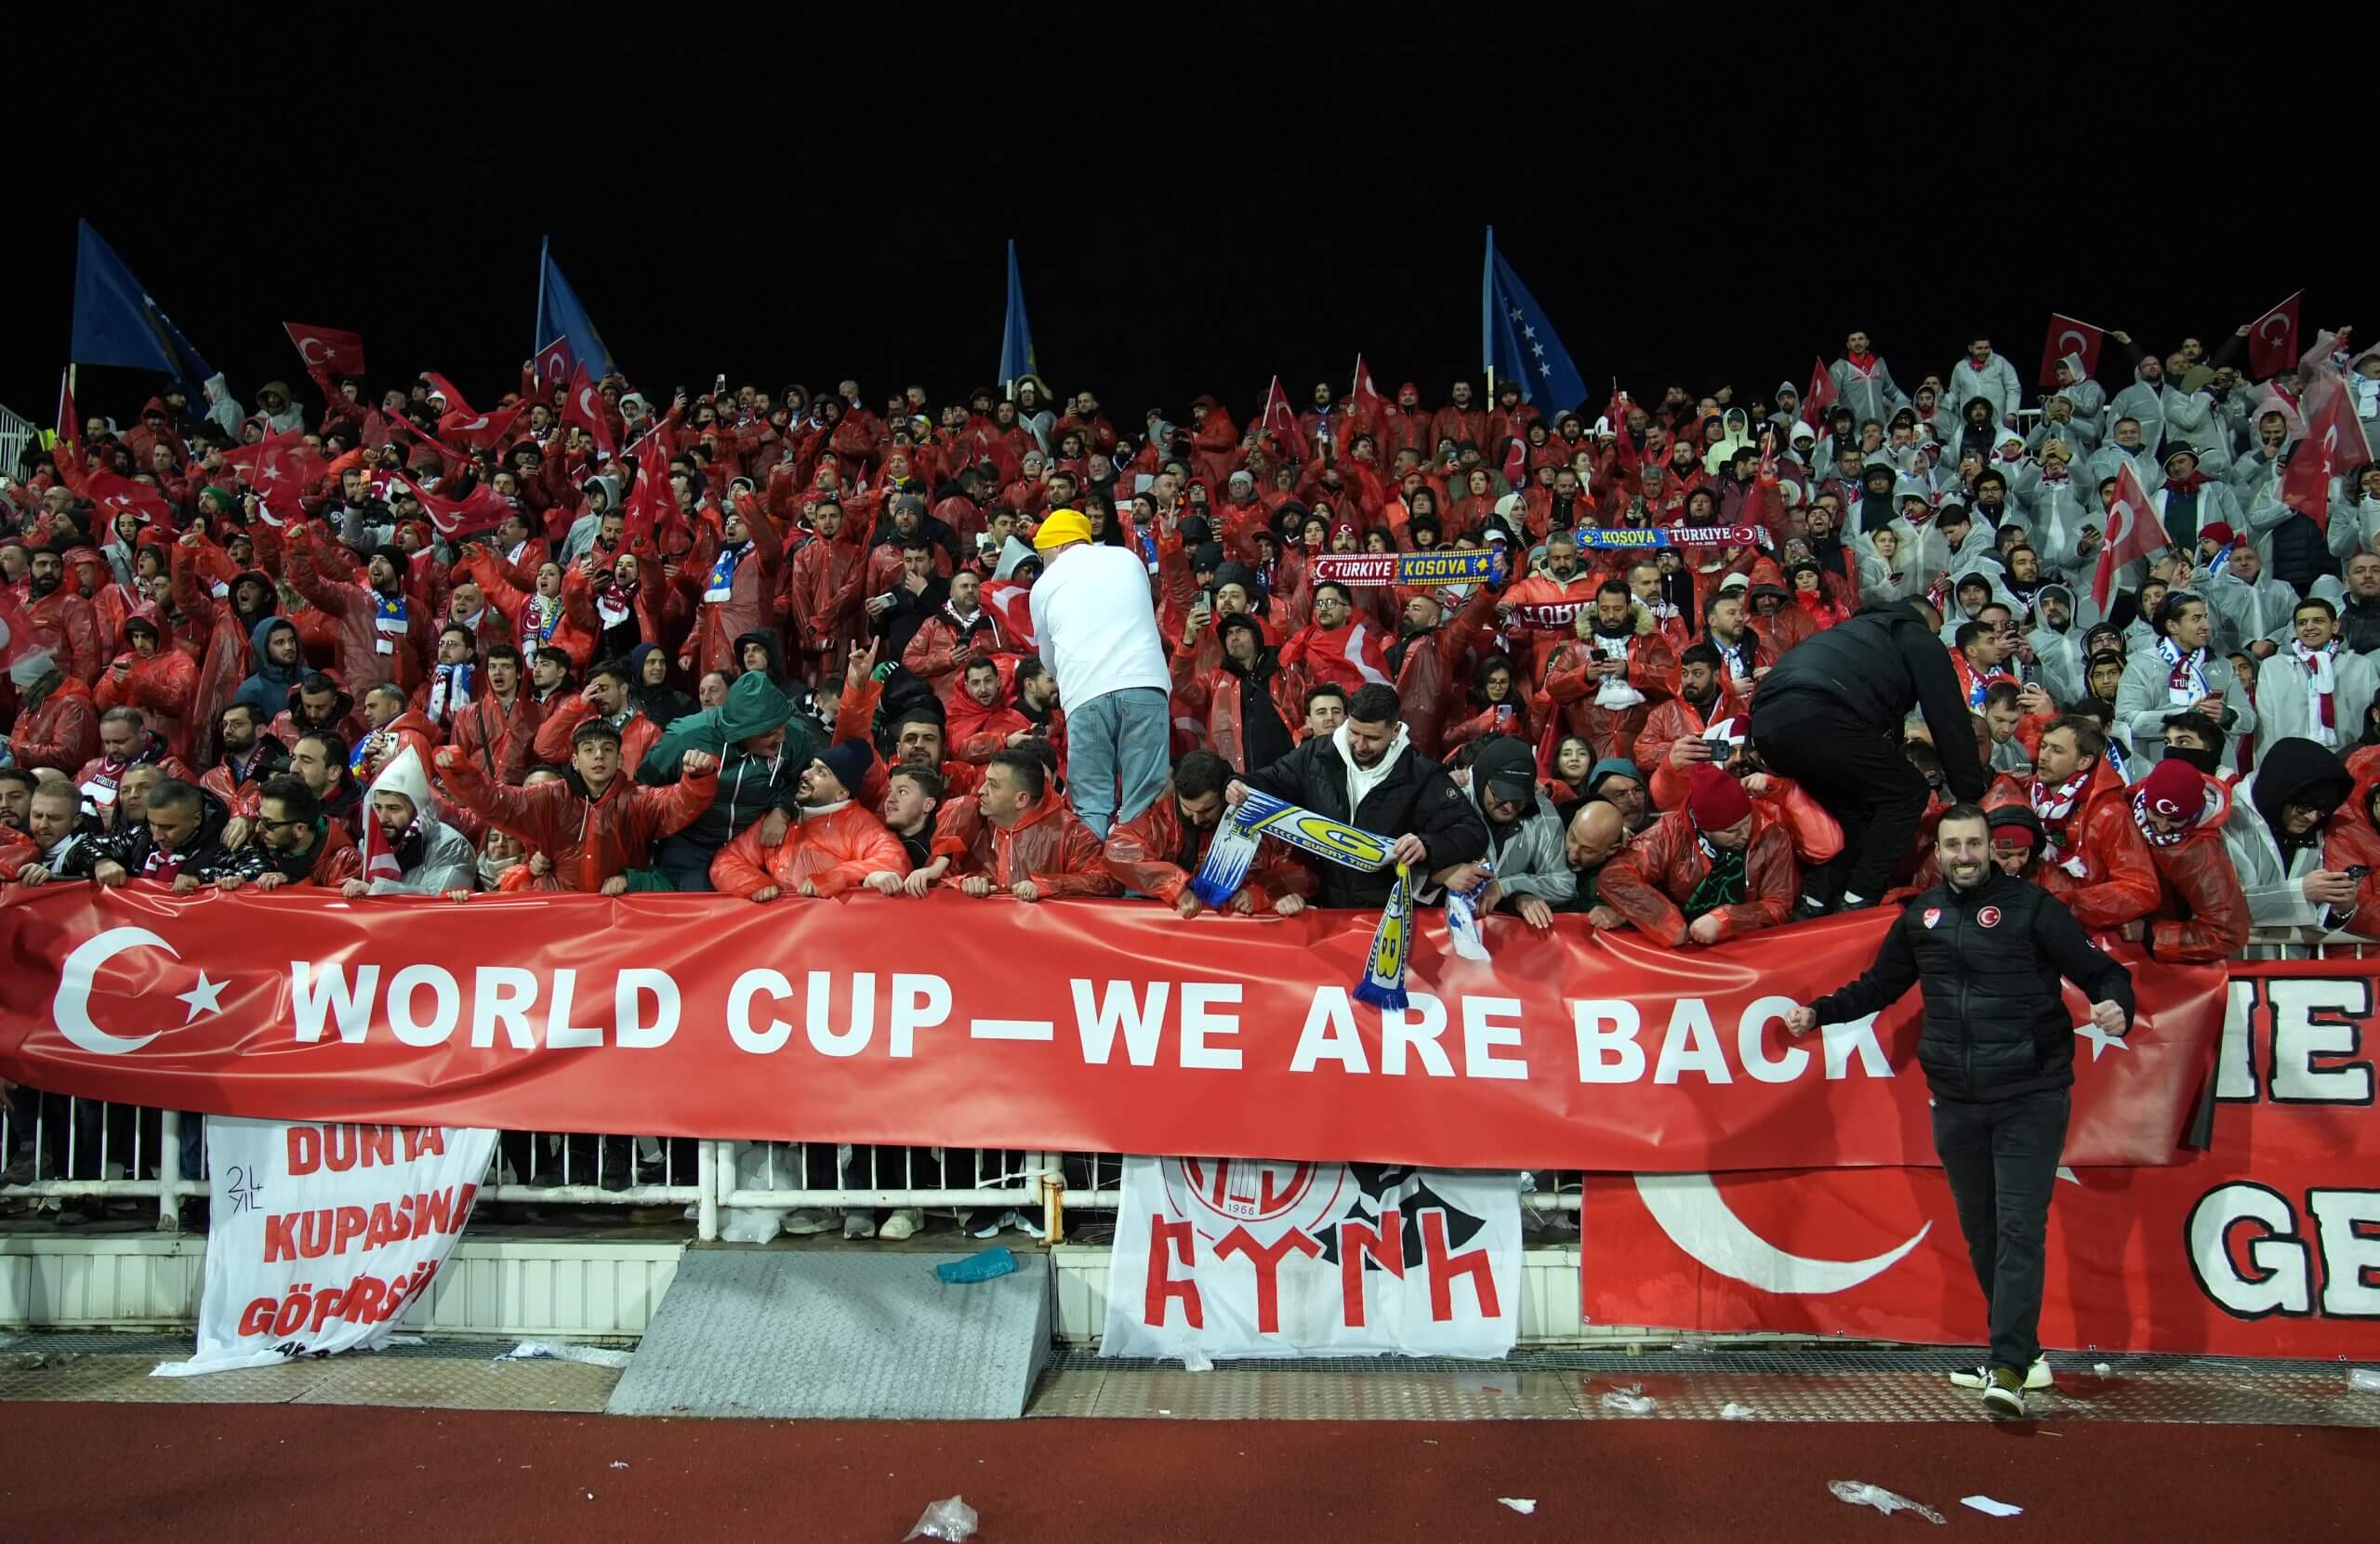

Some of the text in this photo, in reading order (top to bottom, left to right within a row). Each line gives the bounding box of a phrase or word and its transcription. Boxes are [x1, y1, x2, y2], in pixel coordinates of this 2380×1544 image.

[1601, 529, 1656, 544] KOSOVA
[1405, 559, 1467, 575] KOSOVA
[290, 961, 681, 1050] WORLD
[1289, 985, 1529, 1080] ARE
[1573, 996, 1896, 1085] BACK
